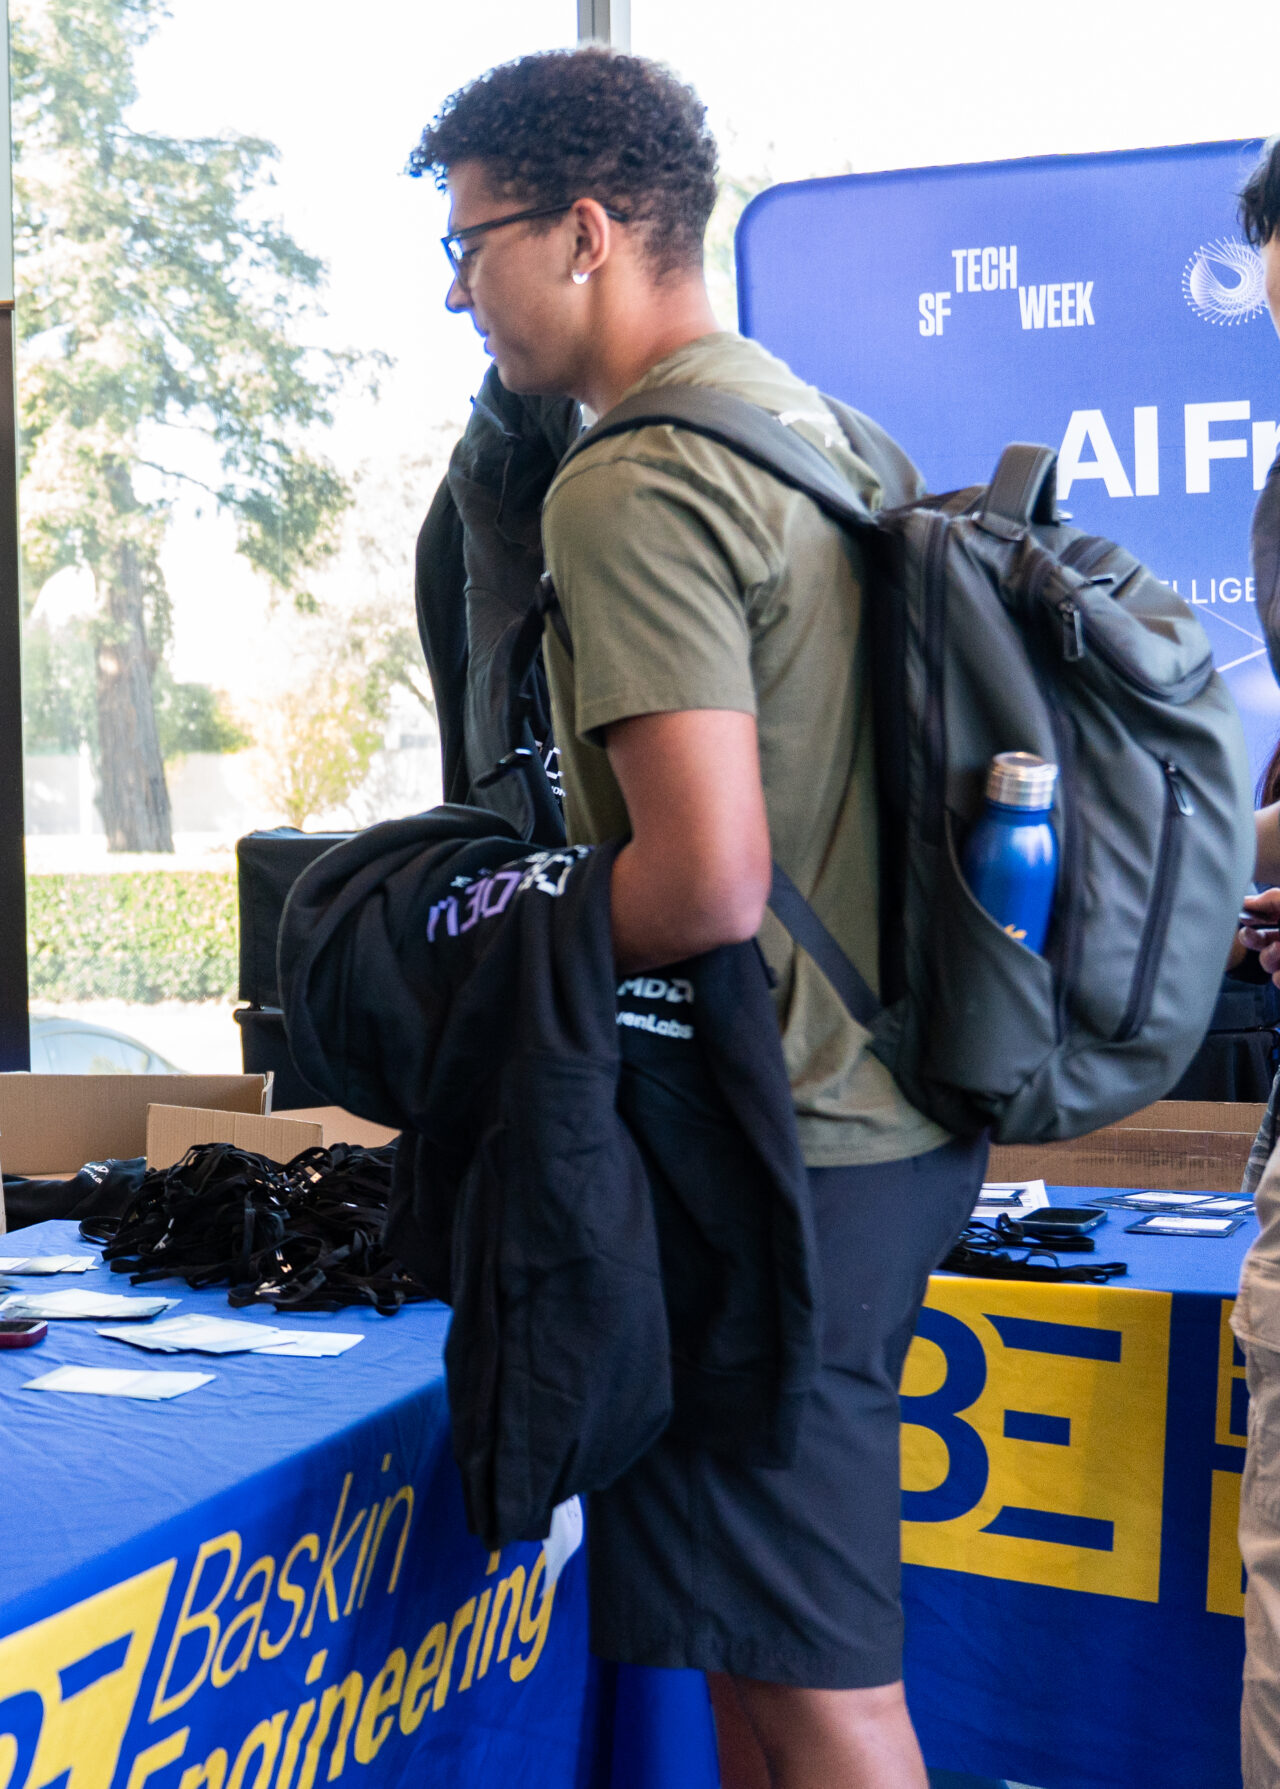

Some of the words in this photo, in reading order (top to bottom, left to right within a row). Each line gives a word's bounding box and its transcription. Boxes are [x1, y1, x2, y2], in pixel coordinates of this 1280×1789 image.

[951, 245, 1017, 293] TECH
[918, 291, 952, 336] SF
[1018, 281, 1096, 330] WEEK
[1056, 406, 1160, 500] AI
[148, 1453, 414, 1724] Baskin
